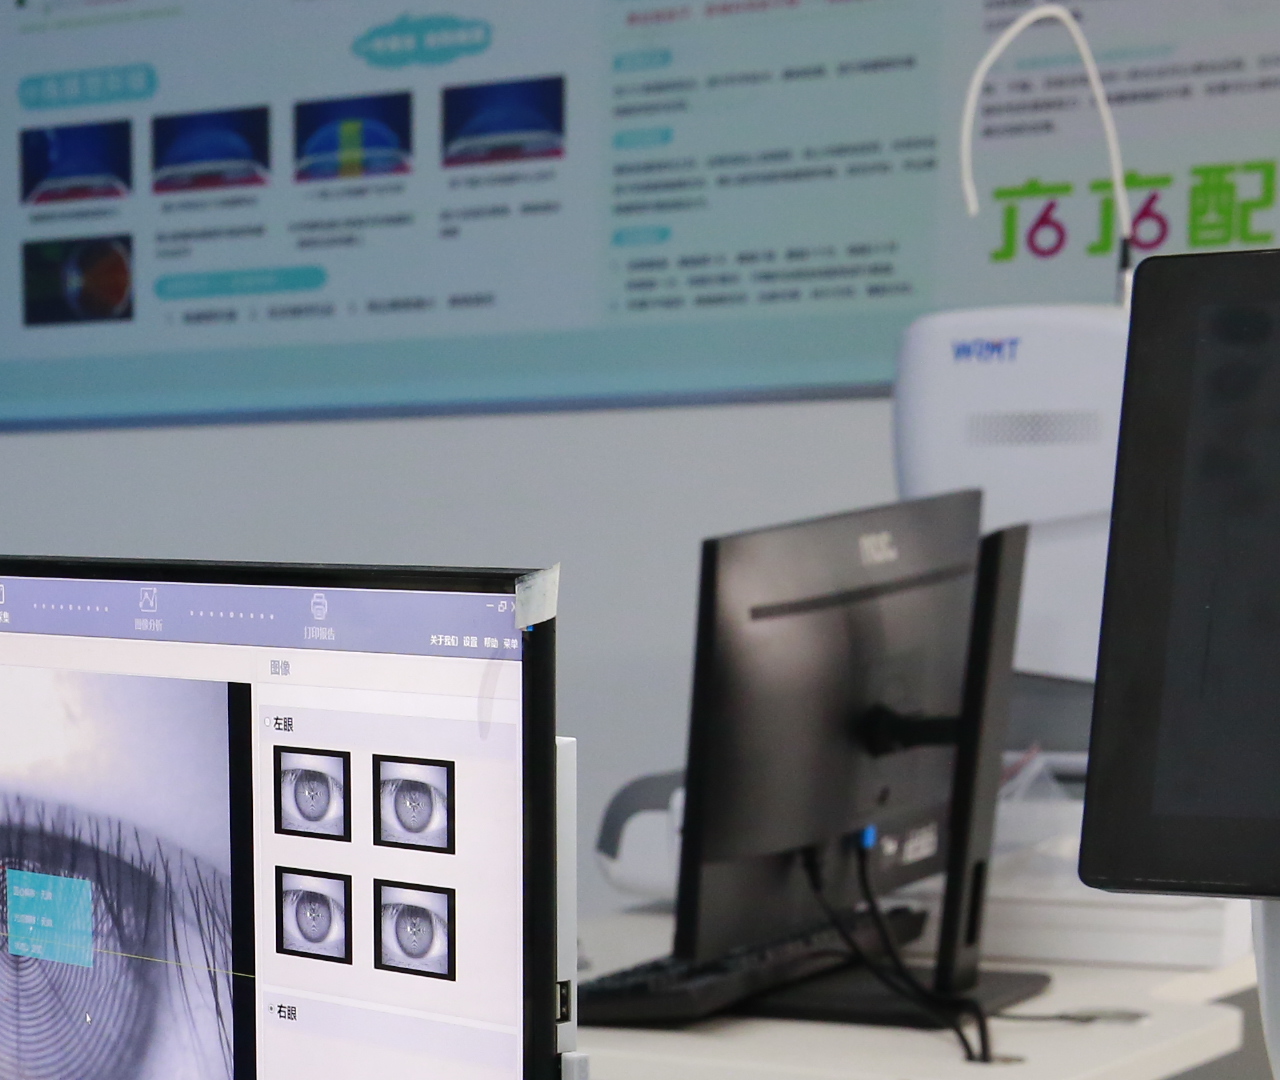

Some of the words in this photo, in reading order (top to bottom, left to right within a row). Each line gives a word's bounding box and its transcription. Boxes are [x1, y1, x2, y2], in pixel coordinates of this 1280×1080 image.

[430, 634, 458, 647] 关于我们
[463, 636, 478, 648] 设置
[270, 659, 291, 676] 图像
[273, 716, 294, 732] 左眼
[277, 1004, 297, 1021] 右眼
